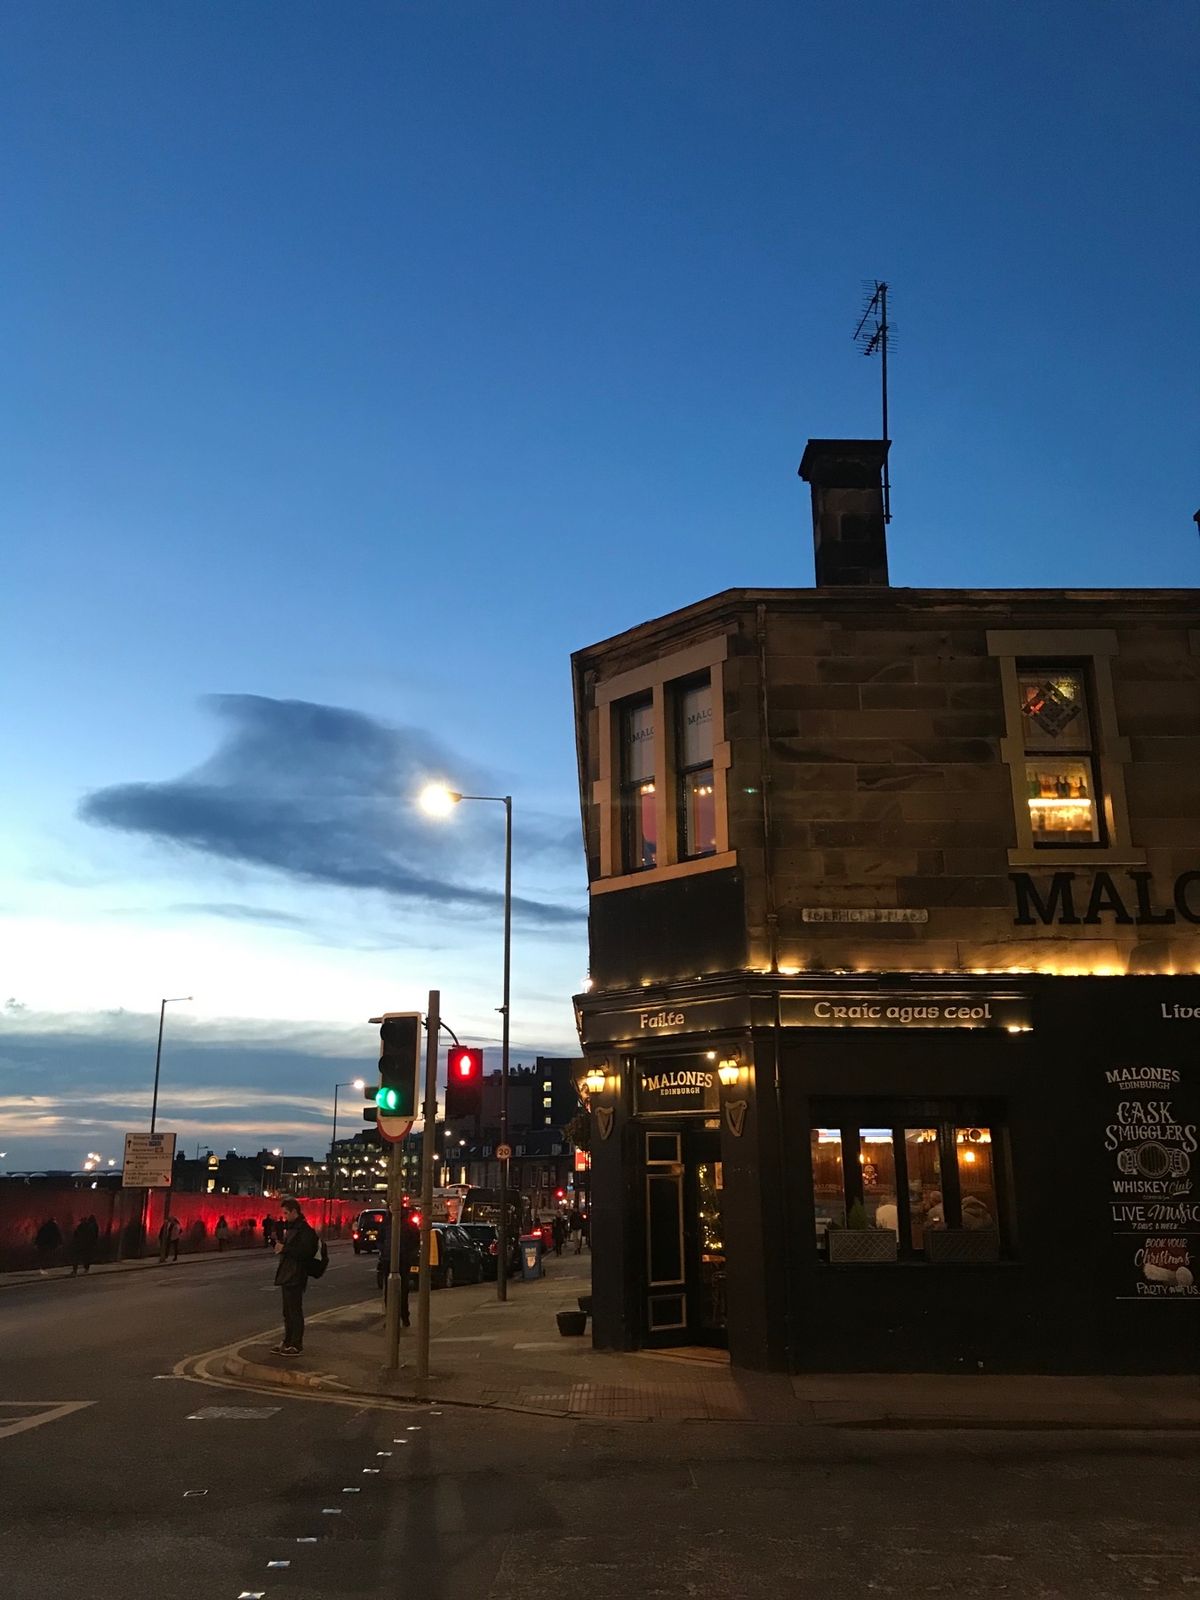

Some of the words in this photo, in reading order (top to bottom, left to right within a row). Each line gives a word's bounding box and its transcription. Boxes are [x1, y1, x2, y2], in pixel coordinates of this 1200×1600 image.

[886, 1005, 940, 1023] agus
[944, 1003, 992, 1019] ceol
[648, 1070, 713, 1091] MALONES
[1105, 1066, 1180, 1083] MALONES
[660, 1086, 700, 1096] EDINBURGH
[1119, 1081, 1170, 1090] EDINBURGH
[1117, 1101, 1177, 1125] CASK
[1105, 1124, 1198, 1153] SMUGGLERS
[499, 1148, 510, 1156] 20
[1112, 1180, 1169, 1193] WHISKEY
[1112, 1205, 1146, 1221] LIVE
[1131, 1222, 1138, 1230] 7
[1145, 1238, 1166, 1248] BOOK
[1134, 1248, 1196, 1267] Christmas
[1136, 1282, 1167, 1295] PARTY
